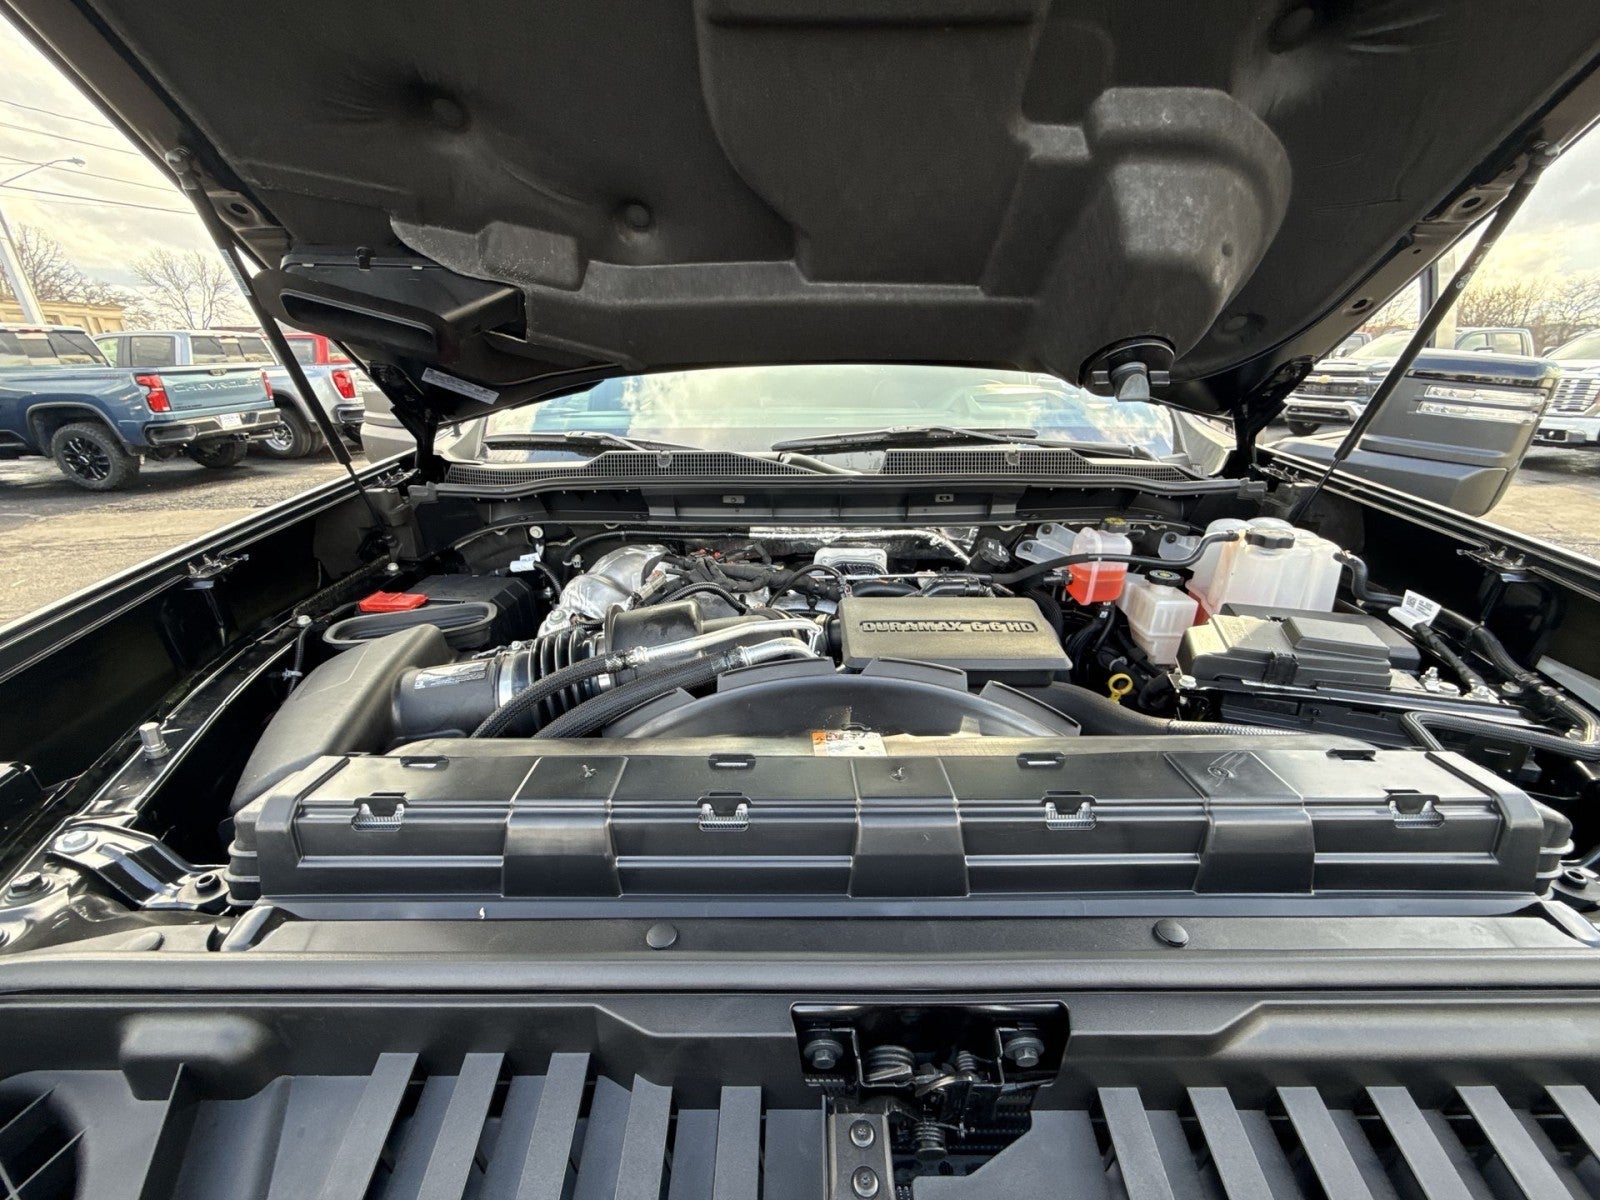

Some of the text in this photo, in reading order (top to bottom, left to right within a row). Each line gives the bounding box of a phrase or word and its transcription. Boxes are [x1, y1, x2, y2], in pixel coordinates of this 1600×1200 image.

[862, 620, 1036, 632] DURAMAX 6.6 HD
